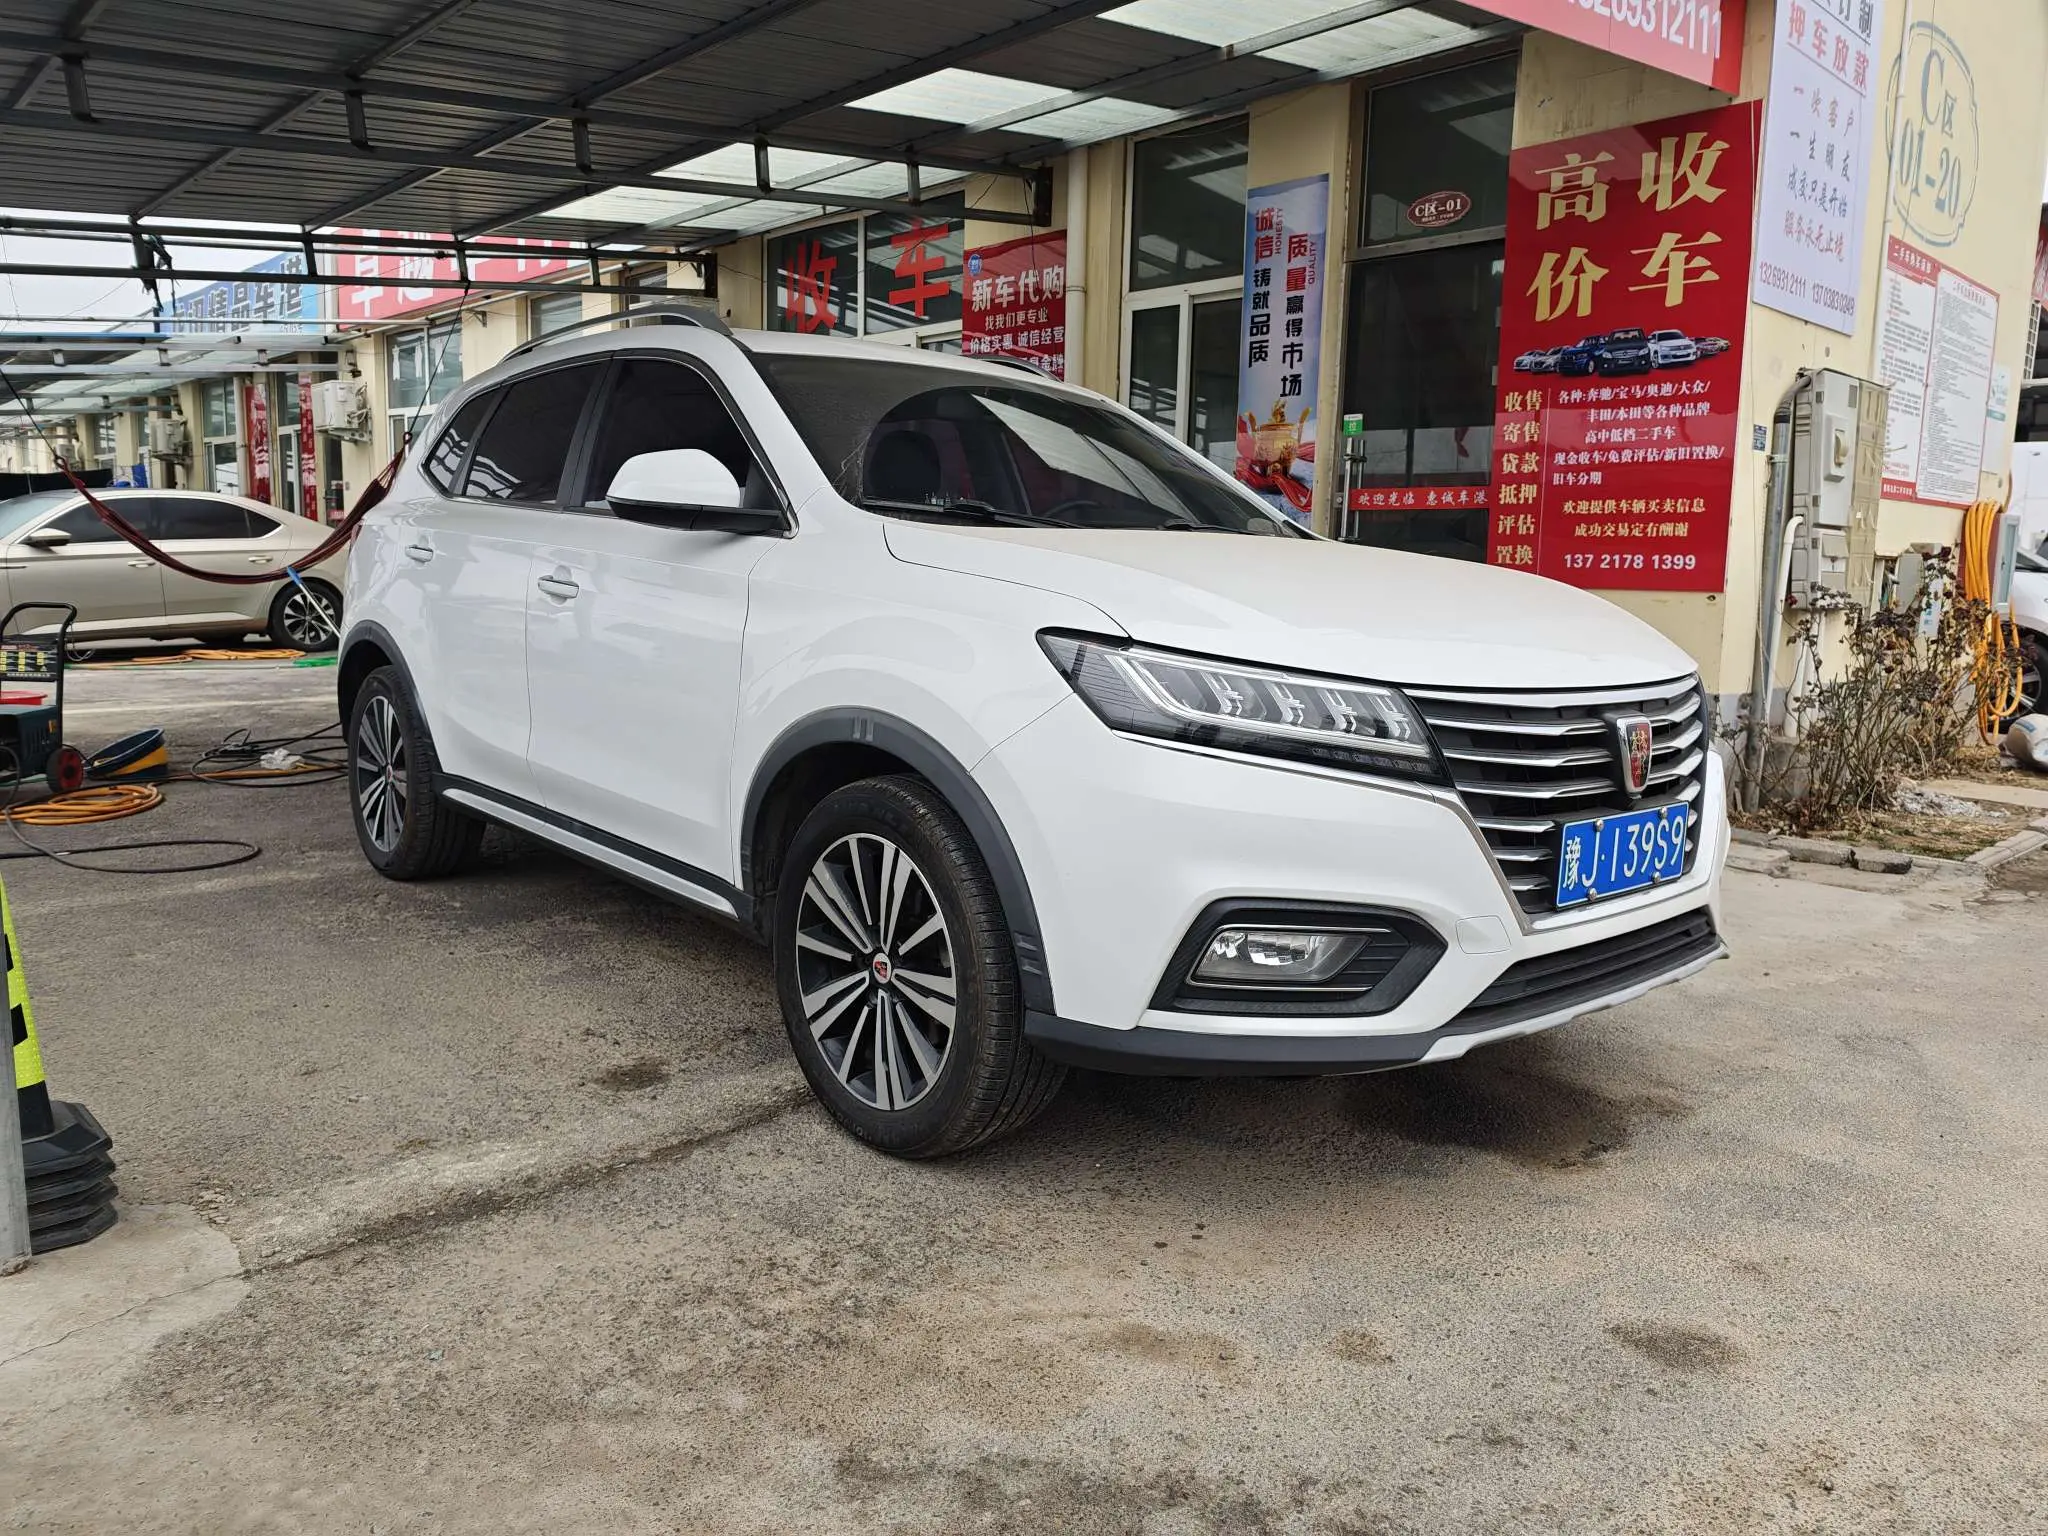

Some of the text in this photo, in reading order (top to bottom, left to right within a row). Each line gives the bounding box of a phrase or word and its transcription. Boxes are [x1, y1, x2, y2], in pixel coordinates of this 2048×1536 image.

[1788, 2, 1870, 92] 押车放款
[1793, 85, 1855, 138] 一次客户
[1789, 130, 1851, 182] 一生朋友
[1899, 118, 1962, 218] 01-20
[1274, 207, 1284, 255] HONESTY
[1307, 240, 1317, 285] QUALITY
[971, 265, 1065, 313] 新车代购
[1248, 206, 1275, 369] 诚信铸就品质
[1759, 261, 1807, 298] 13269312111
[985, 308, 1049, 331] 找我们更专业
[1279, 233, 1308, 398] 质量赢得市场
[970, 326, 1065, 354] 价格实惠 诚信经营
[1504, 390, 1543, 413] 收售
[1587, 402, 1711, 423] 丰田/本田等各种品牌
[1503, 421, 1541, 443] 寄售
[1502, 446, 1725, 474] 贷款 现金收车/免费评估/新旧置换/
[1553, 472, 1602, 486] 旧车分期
[1358, 492, 1415, 507] 欢迎光临
[1499, 483, 1706, 514] 抵押 欢迎提供车辆买卖信息
[1497, 514, 1689, 538] 评估 成功交易定有酬谢
[1496, 545, 1534, 565] 置换
[1564, 554, 1697, 570] 137 2178 1399
